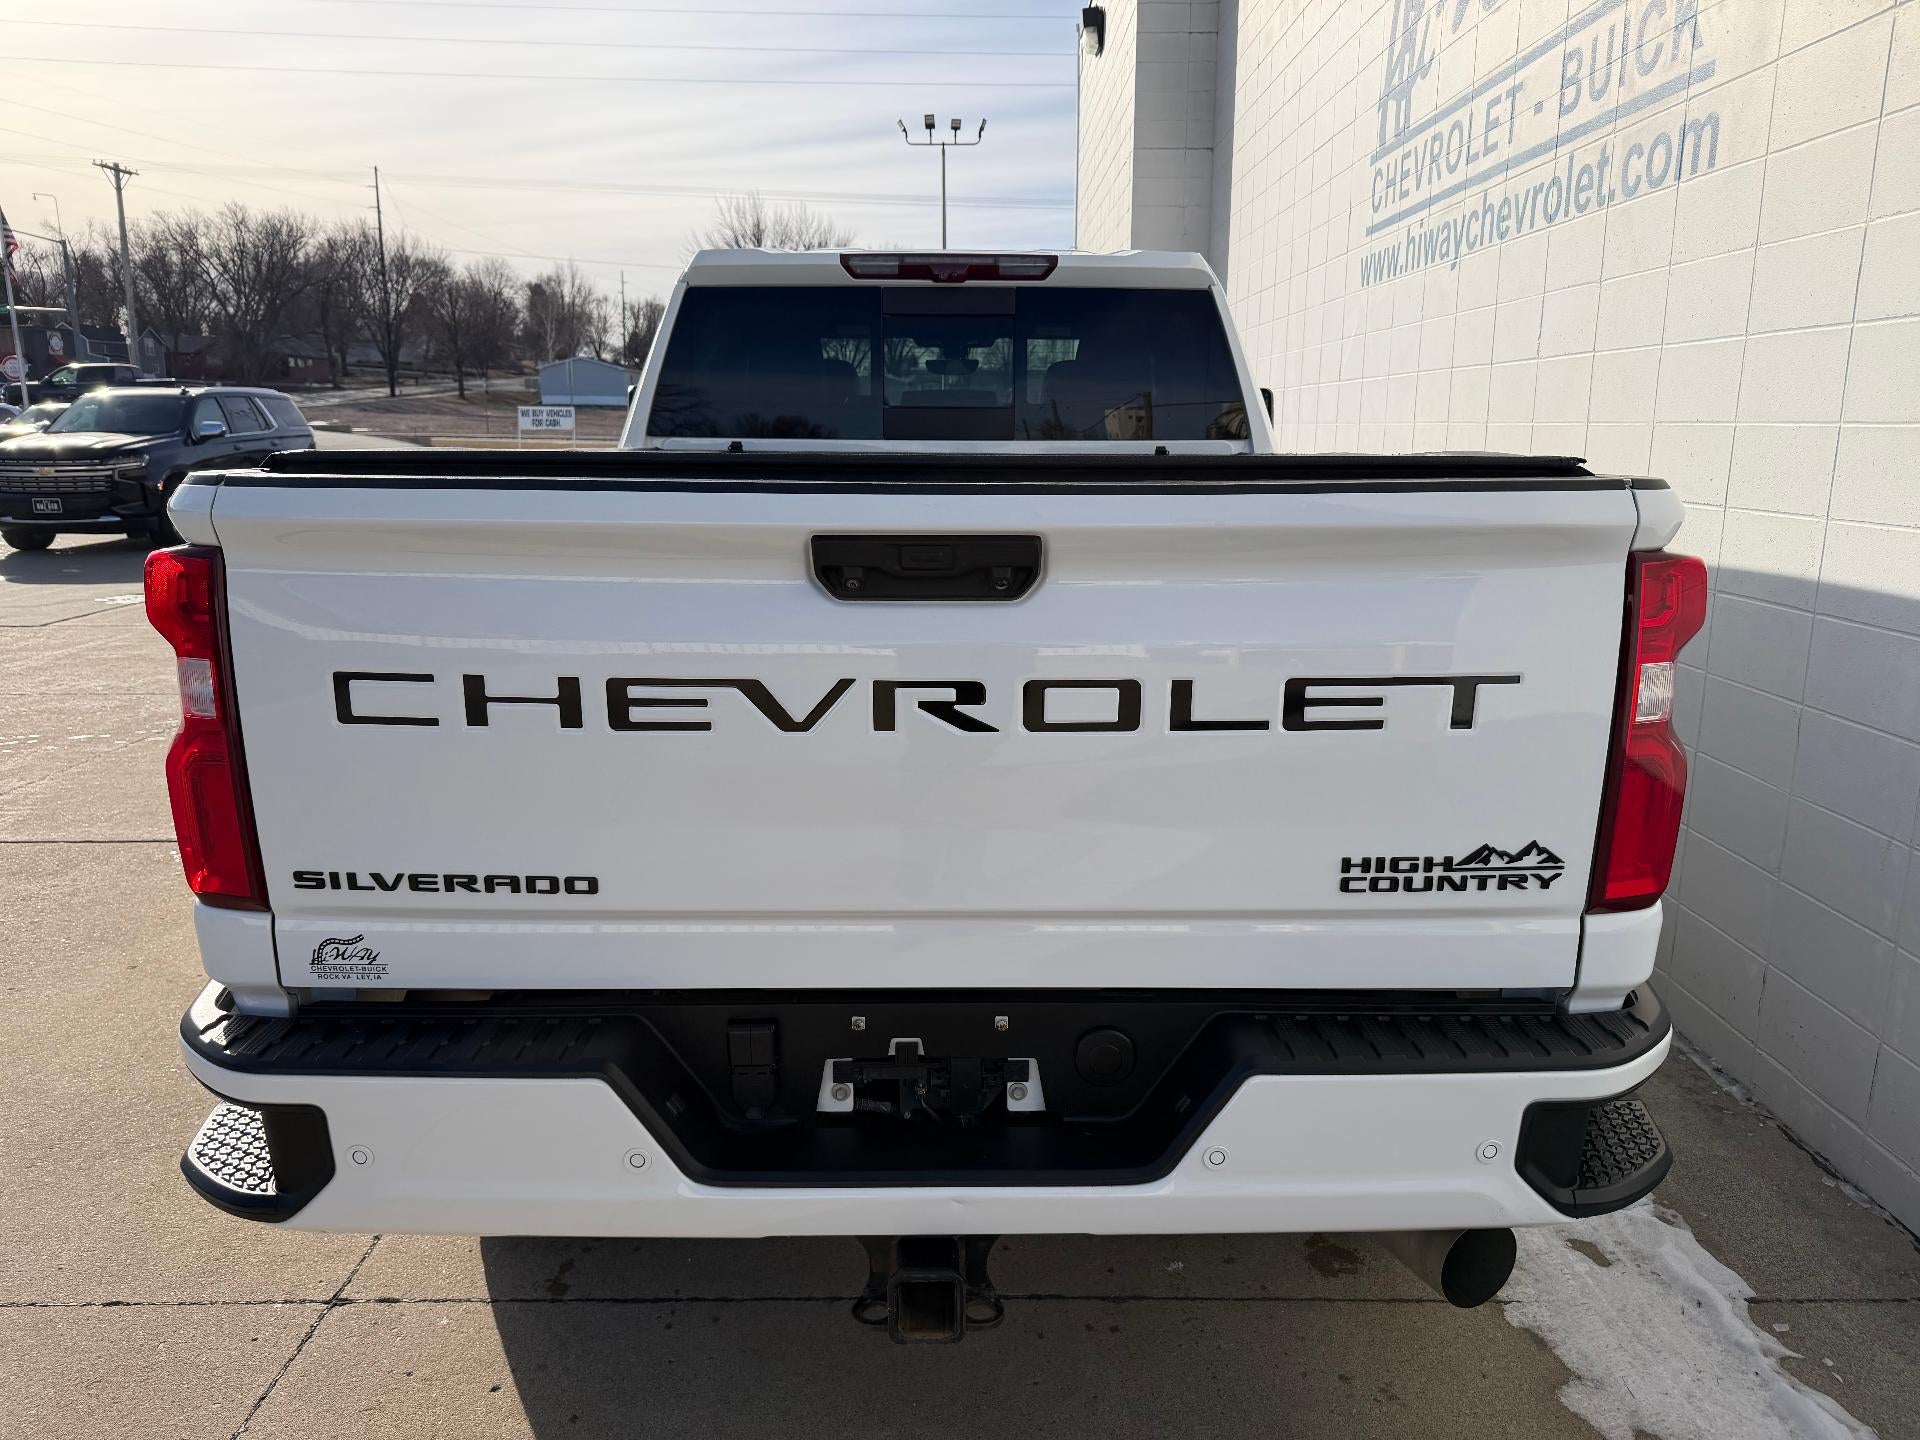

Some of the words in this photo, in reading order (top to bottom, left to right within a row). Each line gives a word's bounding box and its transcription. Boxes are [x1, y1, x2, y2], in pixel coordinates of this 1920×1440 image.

[1372, 82, 1523, 214] CHEVROLET
[1559, 0, 1705, 118] BUICK
[1360, 111, 1721, 288] www.hiwaychevrolet.com
[521, 409, 530, 418] WE
[532, 409, 544, 418] BUY
[532, 419, 543, 427] FOR
[545, 419, 561, 427] CASH
[333, 671, 1521, 732] CHEVROLET
[1341, 856, 1453, 873] HIGH
[293, 871, 599, 894] SILVERADO
[1340, 873, 1563, 893] COUNTRY
